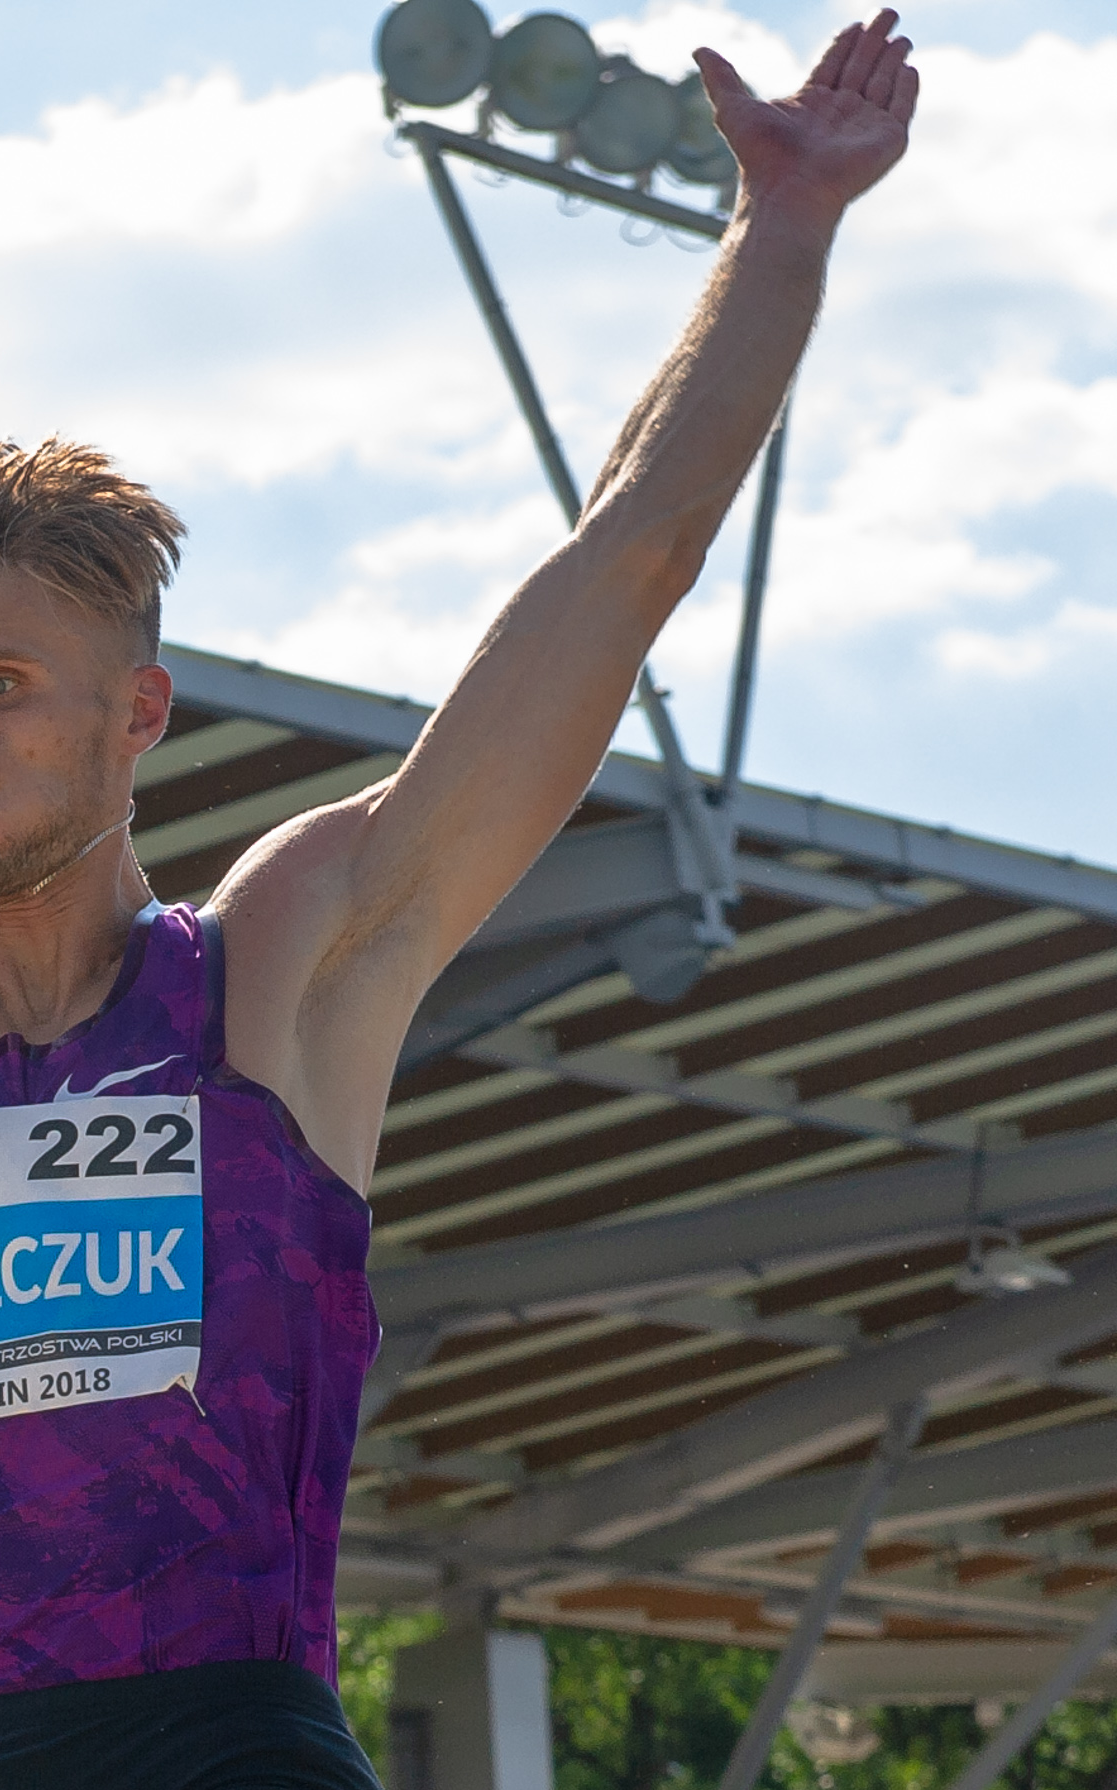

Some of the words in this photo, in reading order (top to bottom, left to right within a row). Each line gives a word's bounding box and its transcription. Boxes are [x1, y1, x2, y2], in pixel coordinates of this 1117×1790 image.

[26, 1113, 196, 1181] 222
[107, 1328, 183, 1350] POLSKI
[39, 1367, 112, 1400] 2018
